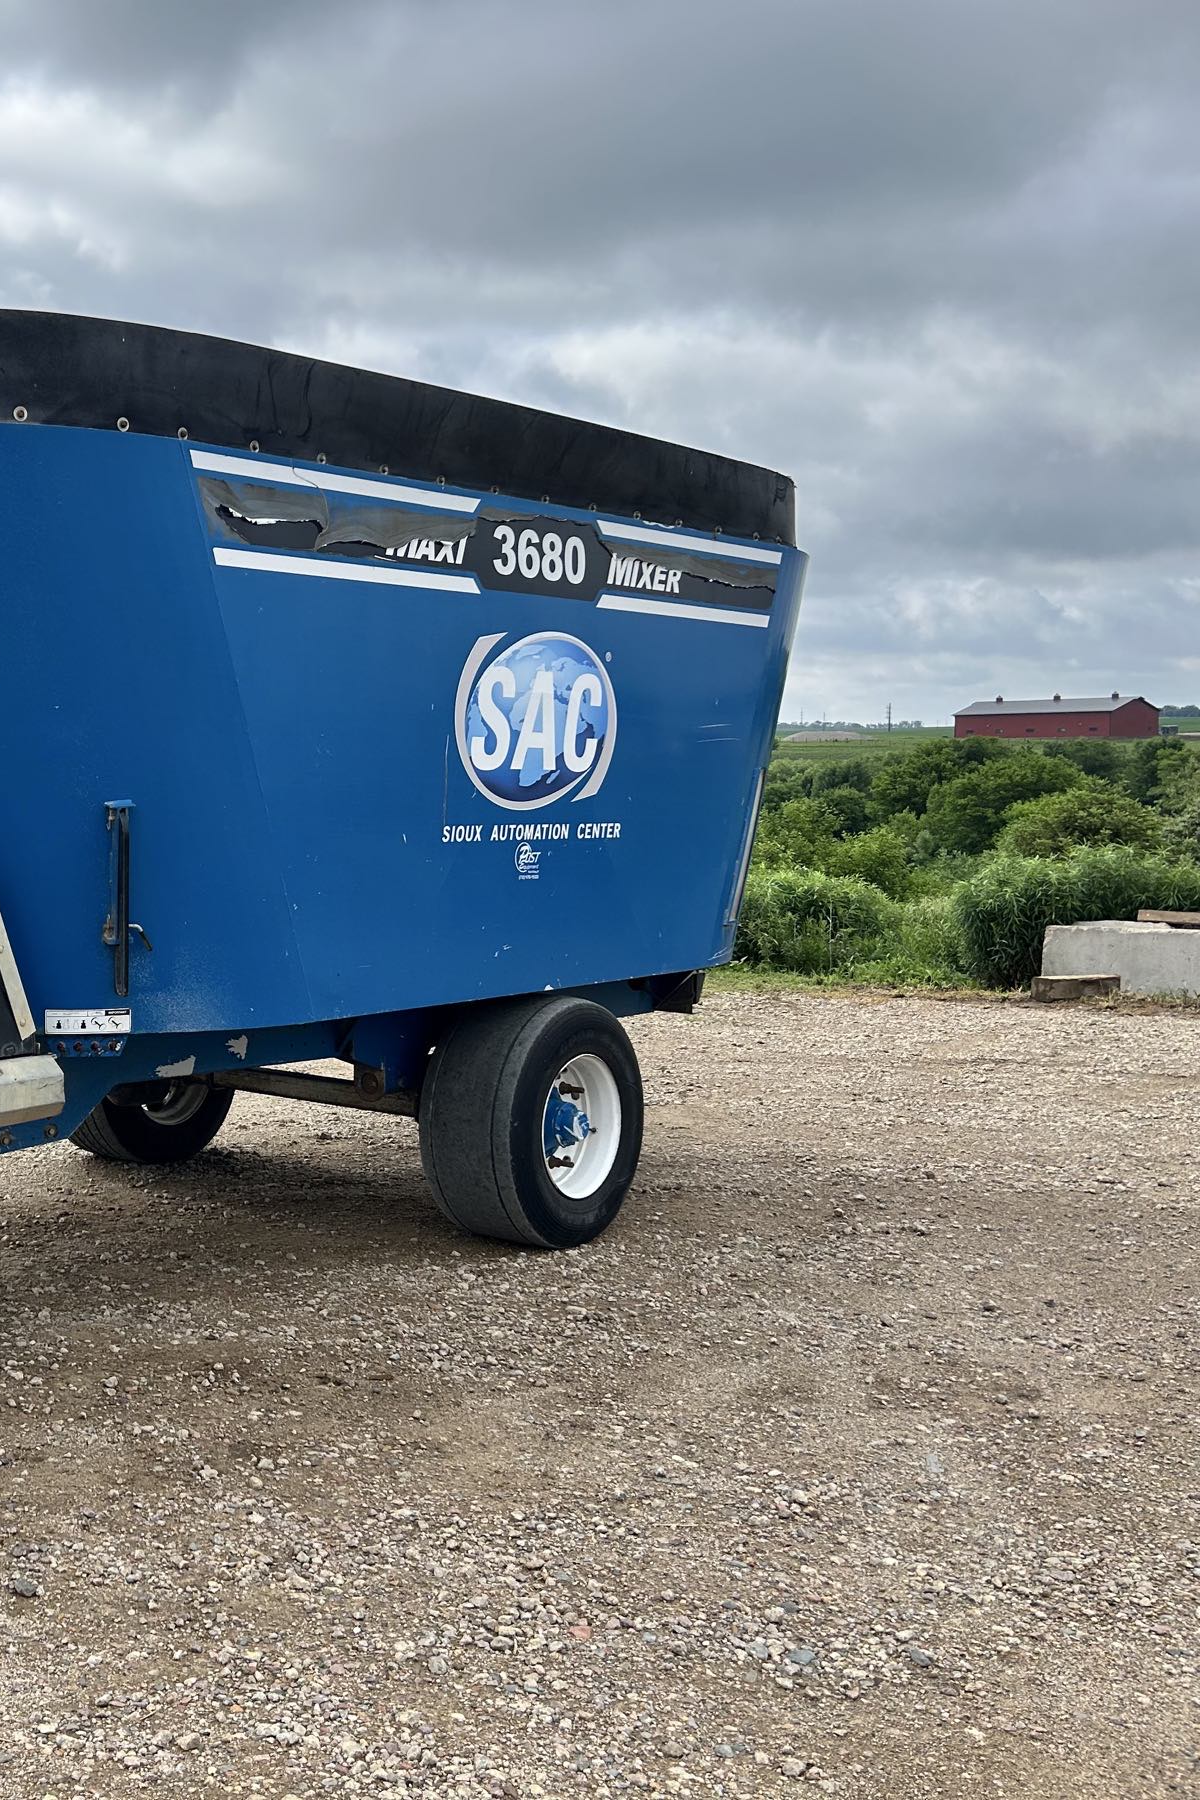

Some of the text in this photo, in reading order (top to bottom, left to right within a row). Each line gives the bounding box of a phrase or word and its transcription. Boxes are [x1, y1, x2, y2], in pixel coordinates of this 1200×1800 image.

[492, 525, 586, 585] 3680
[606, 552, 682, 594] MIXER
[471, 665, 602, 773] SAC
[441, 822, 622, 843] SIOUX AUTOMATION CENTER
